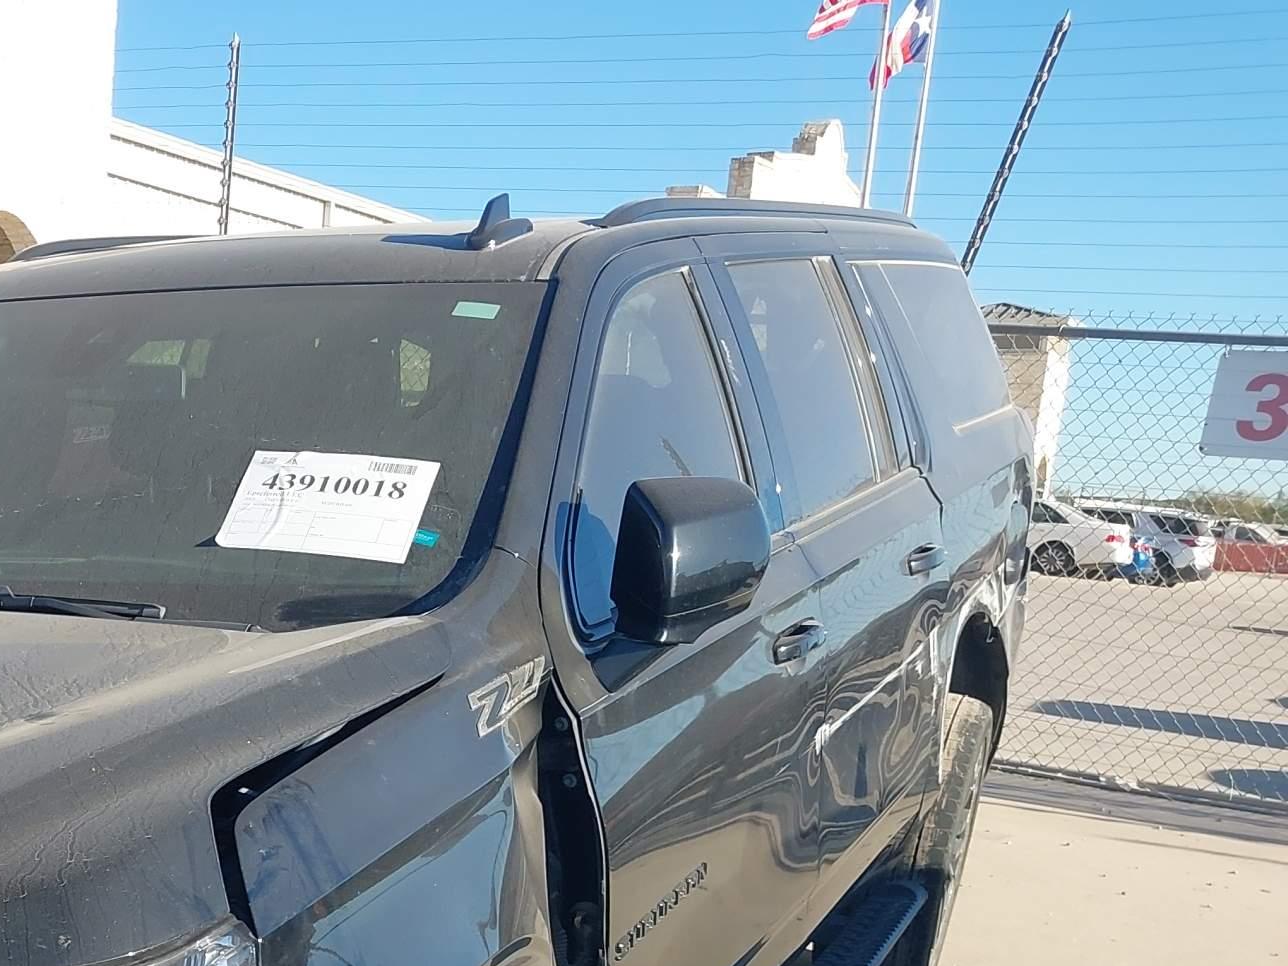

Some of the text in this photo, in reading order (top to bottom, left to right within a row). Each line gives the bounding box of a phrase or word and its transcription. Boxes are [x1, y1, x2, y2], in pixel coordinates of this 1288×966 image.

[1236, 372, 1288, 442] 3
[261, 471, 408, 500] 43910018
[468, 655, 546, 738] Z71
